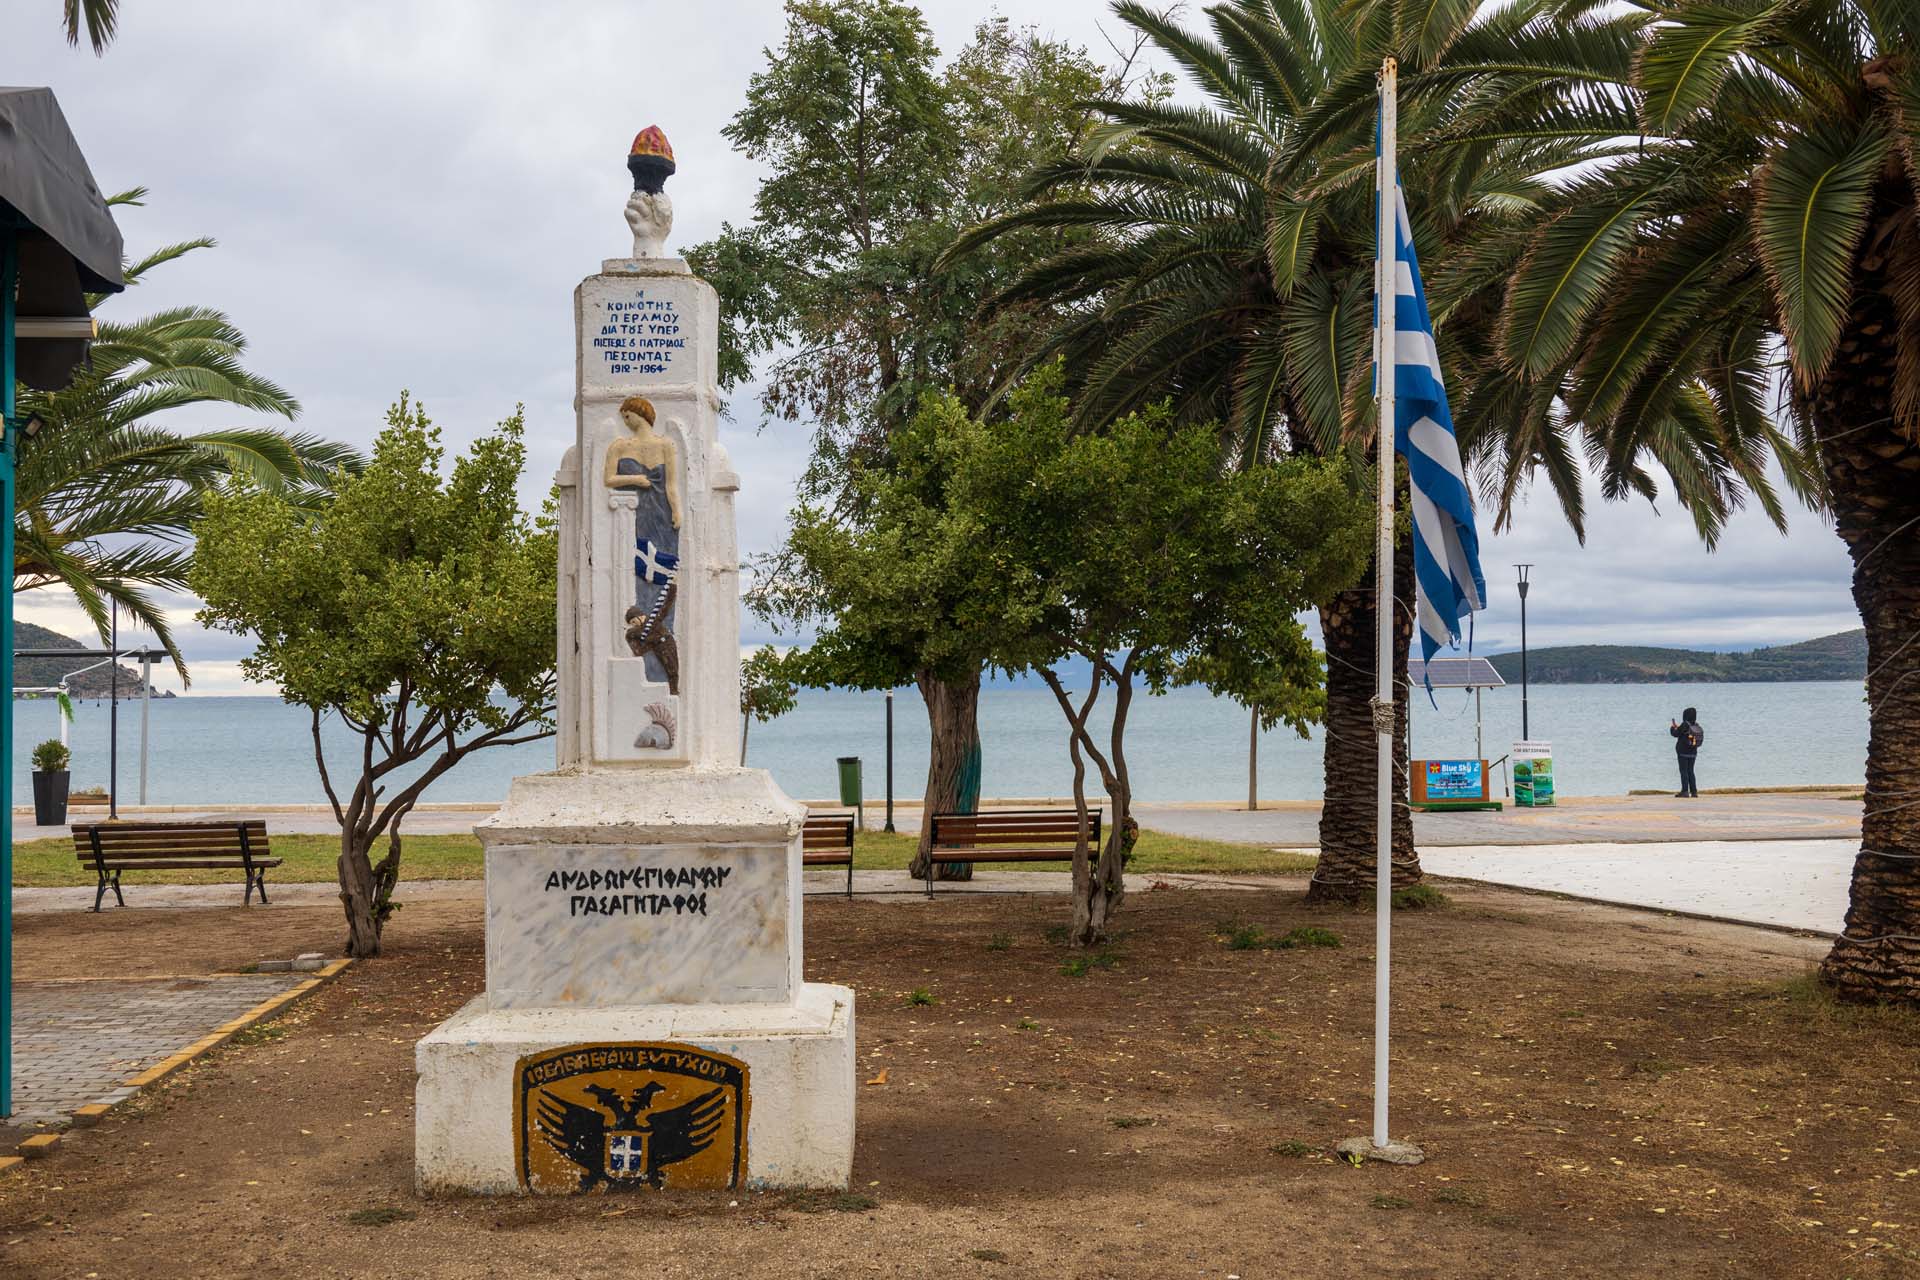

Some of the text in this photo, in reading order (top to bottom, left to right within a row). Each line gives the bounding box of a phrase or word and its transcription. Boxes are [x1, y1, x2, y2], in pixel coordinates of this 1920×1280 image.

[607, 301, 673, 311] ΚΟΙΝΟΤΗΣ
[601, 325, 617, 335] ΔΙΑ
[649, 324, 679, 335] ΥΠΕΡ
[639, 338, 685, 348] ΠΑΤΡΙΔΟΣ
[604, 351, 672, 362] ΠΕΣΟΝΤΑΣ
[1441, 764, 1457, 772] Blue
